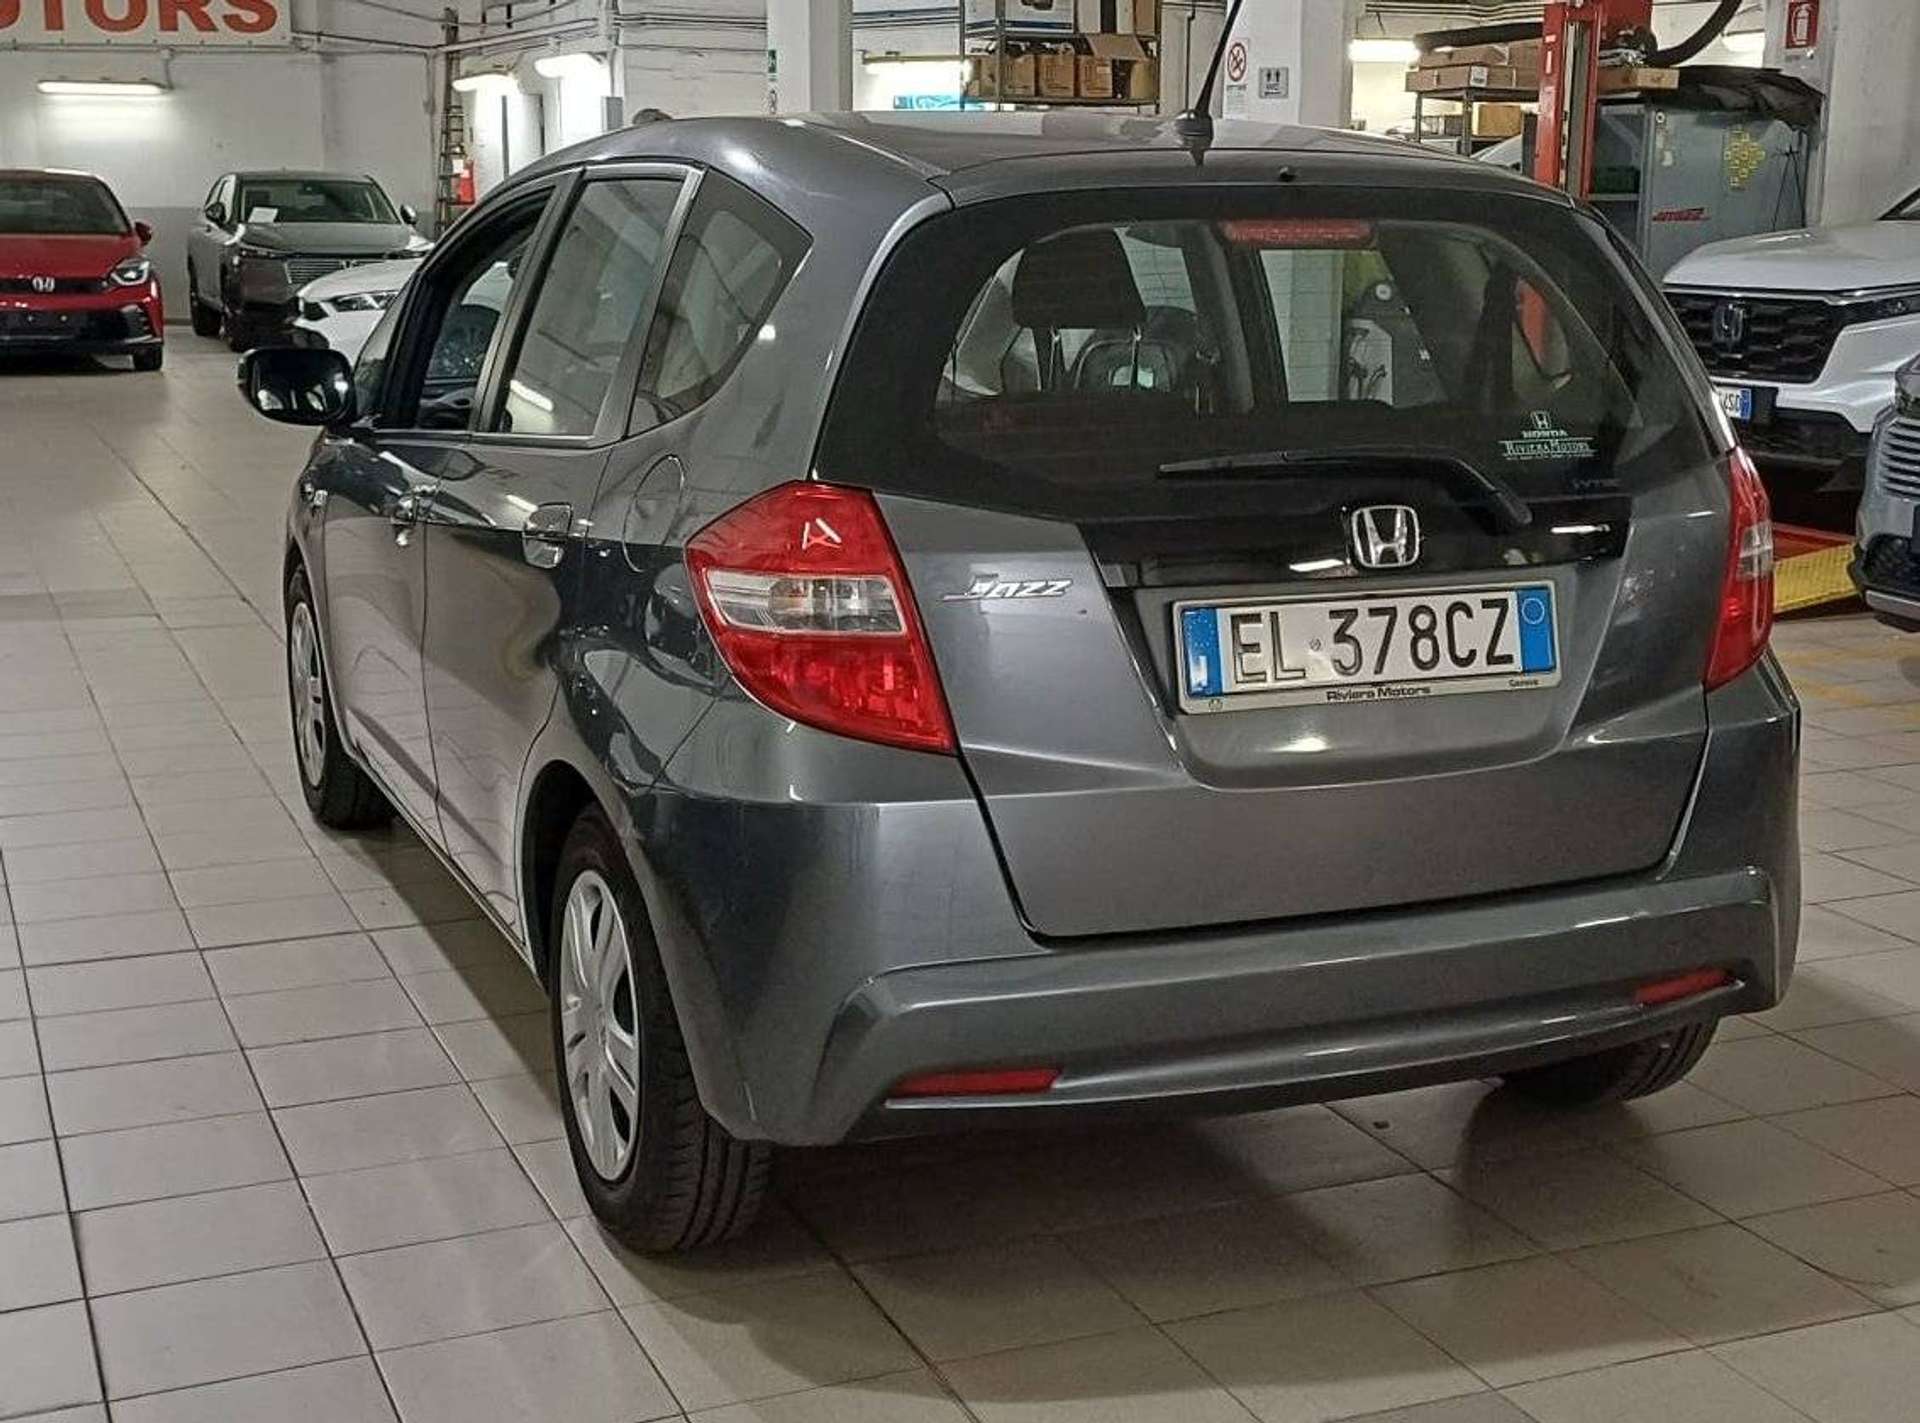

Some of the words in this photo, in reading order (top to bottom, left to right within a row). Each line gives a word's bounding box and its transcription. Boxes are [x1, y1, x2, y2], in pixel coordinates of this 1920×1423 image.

[1229, 611, 1306, 684] EL
[1328, 598, 1515, 678] 378CZ
[1326, 688, 1375, 701] Riviera
[1377, 686, 1431, 699] Motors
